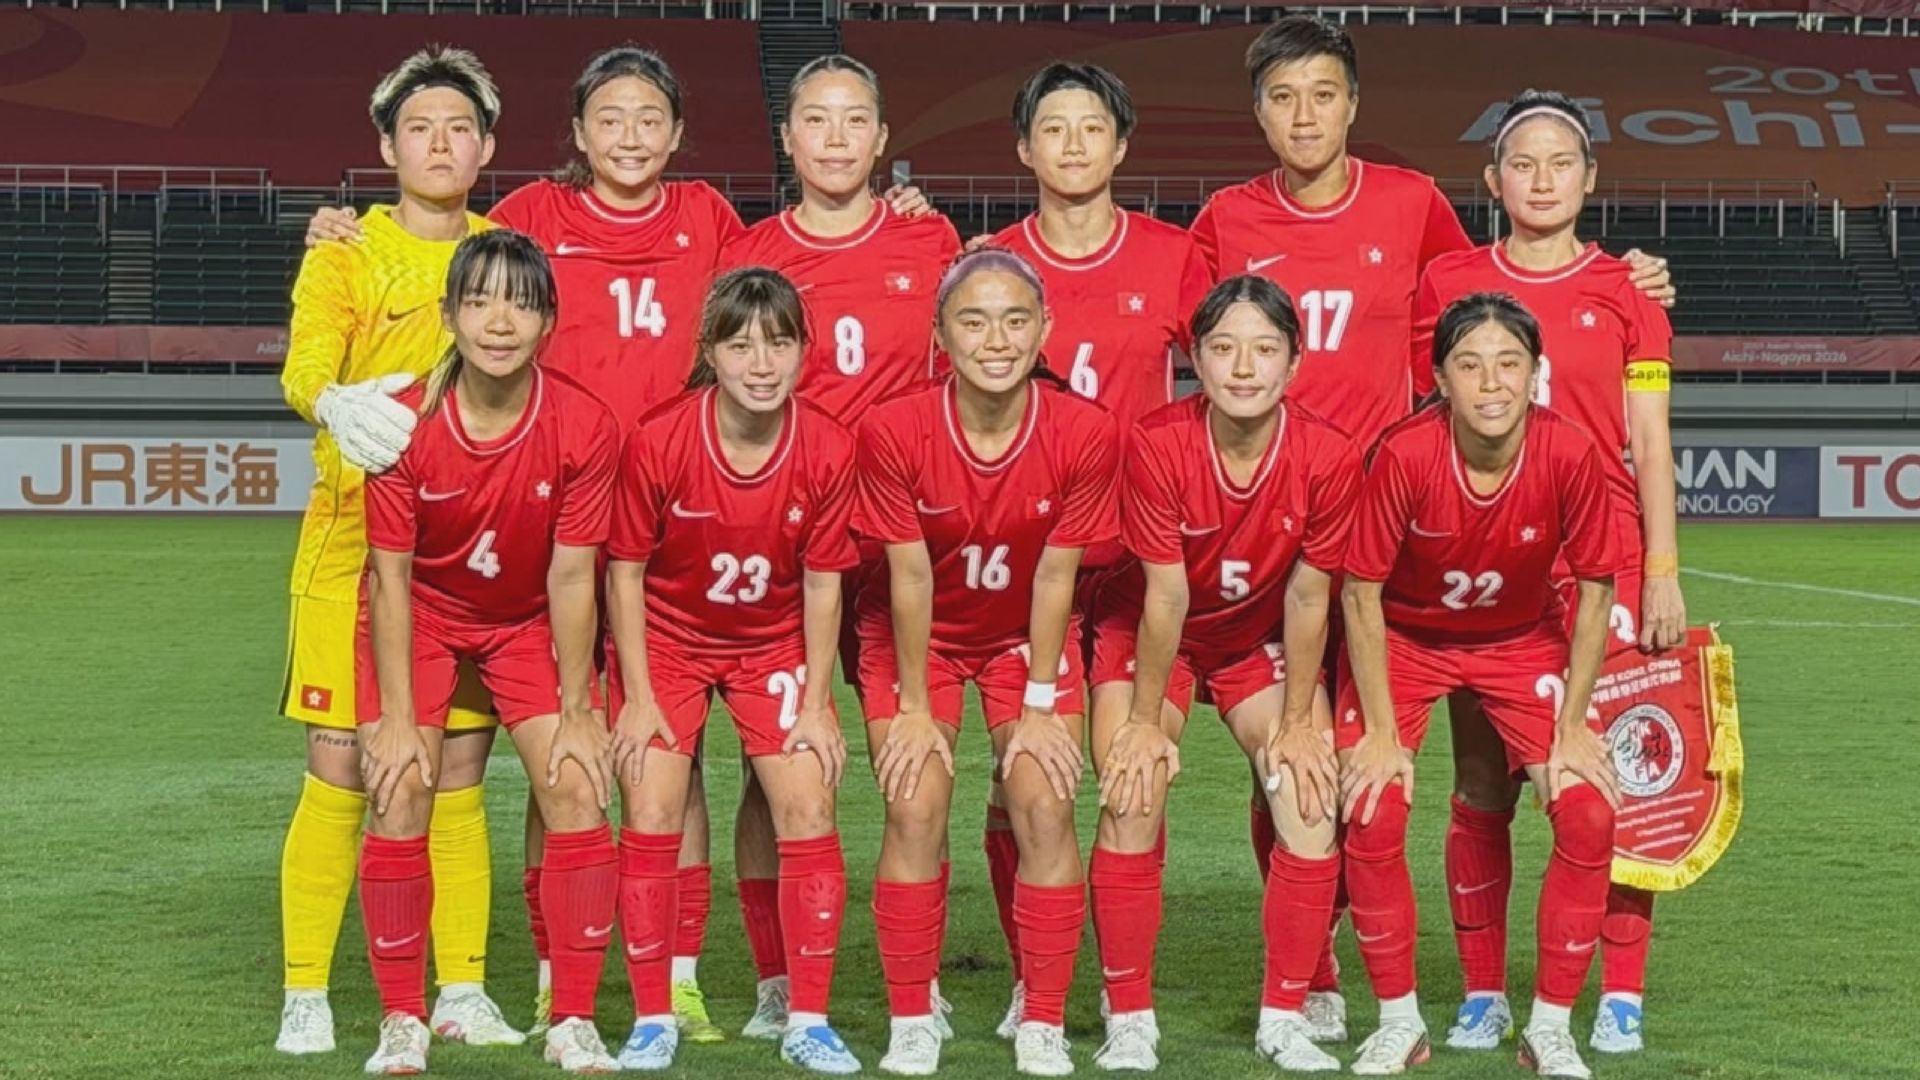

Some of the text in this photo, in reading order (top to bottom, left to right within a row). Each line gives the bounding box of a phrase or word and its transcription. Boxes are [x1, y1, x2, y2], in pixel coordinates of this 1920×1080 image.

[1707, 66, 1920, 95] 20t
[608, 277, 668, 337] 14
[1300, 289, 1354, 352] 17
[834, 315, 865, 375] 8
[1070, 342, 1098, 399] 6
[21, 442, 280, 506] JR東海
[1674, 448, 1777, 489] NAN
[467, 530, 500, 577] 4
[706, 552, 771, 604] 23
[961, 545, 1010, 589] 16
[1220, 560, 1250, 600] 5
[1441, 570, 1503, 609] 22
[767, 664, 806, 731] 2
[1534, 667, 1569, 721] 2
